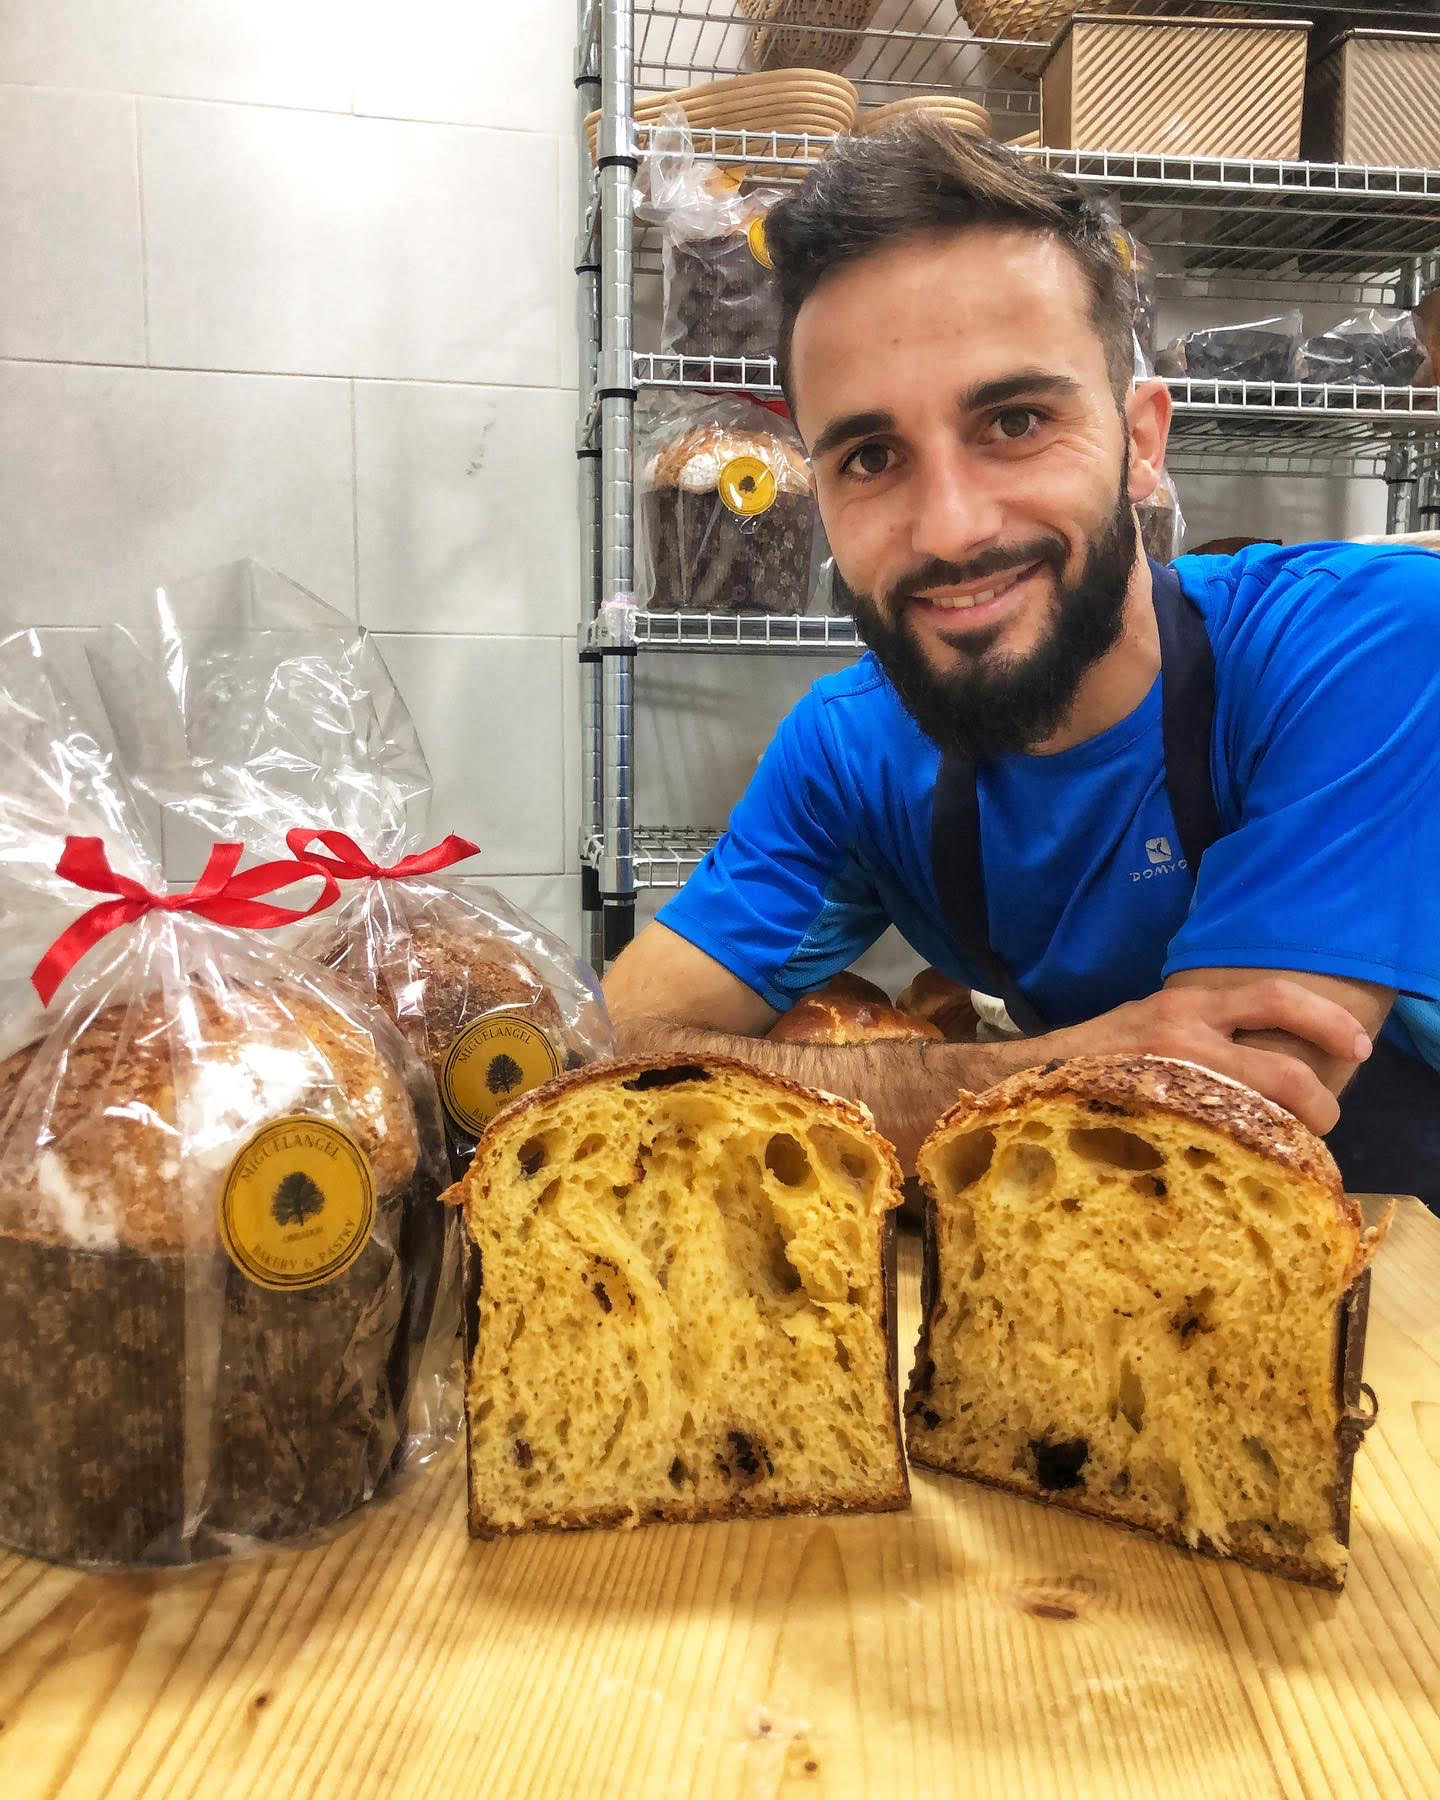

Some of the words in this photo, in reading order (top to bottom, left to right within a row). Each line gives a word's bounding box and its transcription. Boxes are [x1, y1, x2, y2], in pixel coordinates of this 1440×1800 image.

[1129, 858, 1188, 882] DOMYO
[458, 1026, 532, 1063] MIGUELANGEL
[241, 1134, 340, 1182] MIGUELANGEL
[252, 1244, 298, 1270] BAKERY
[303, 1258, 314, 1269] &
[318, 1219, 355, 1262] PASTRY
